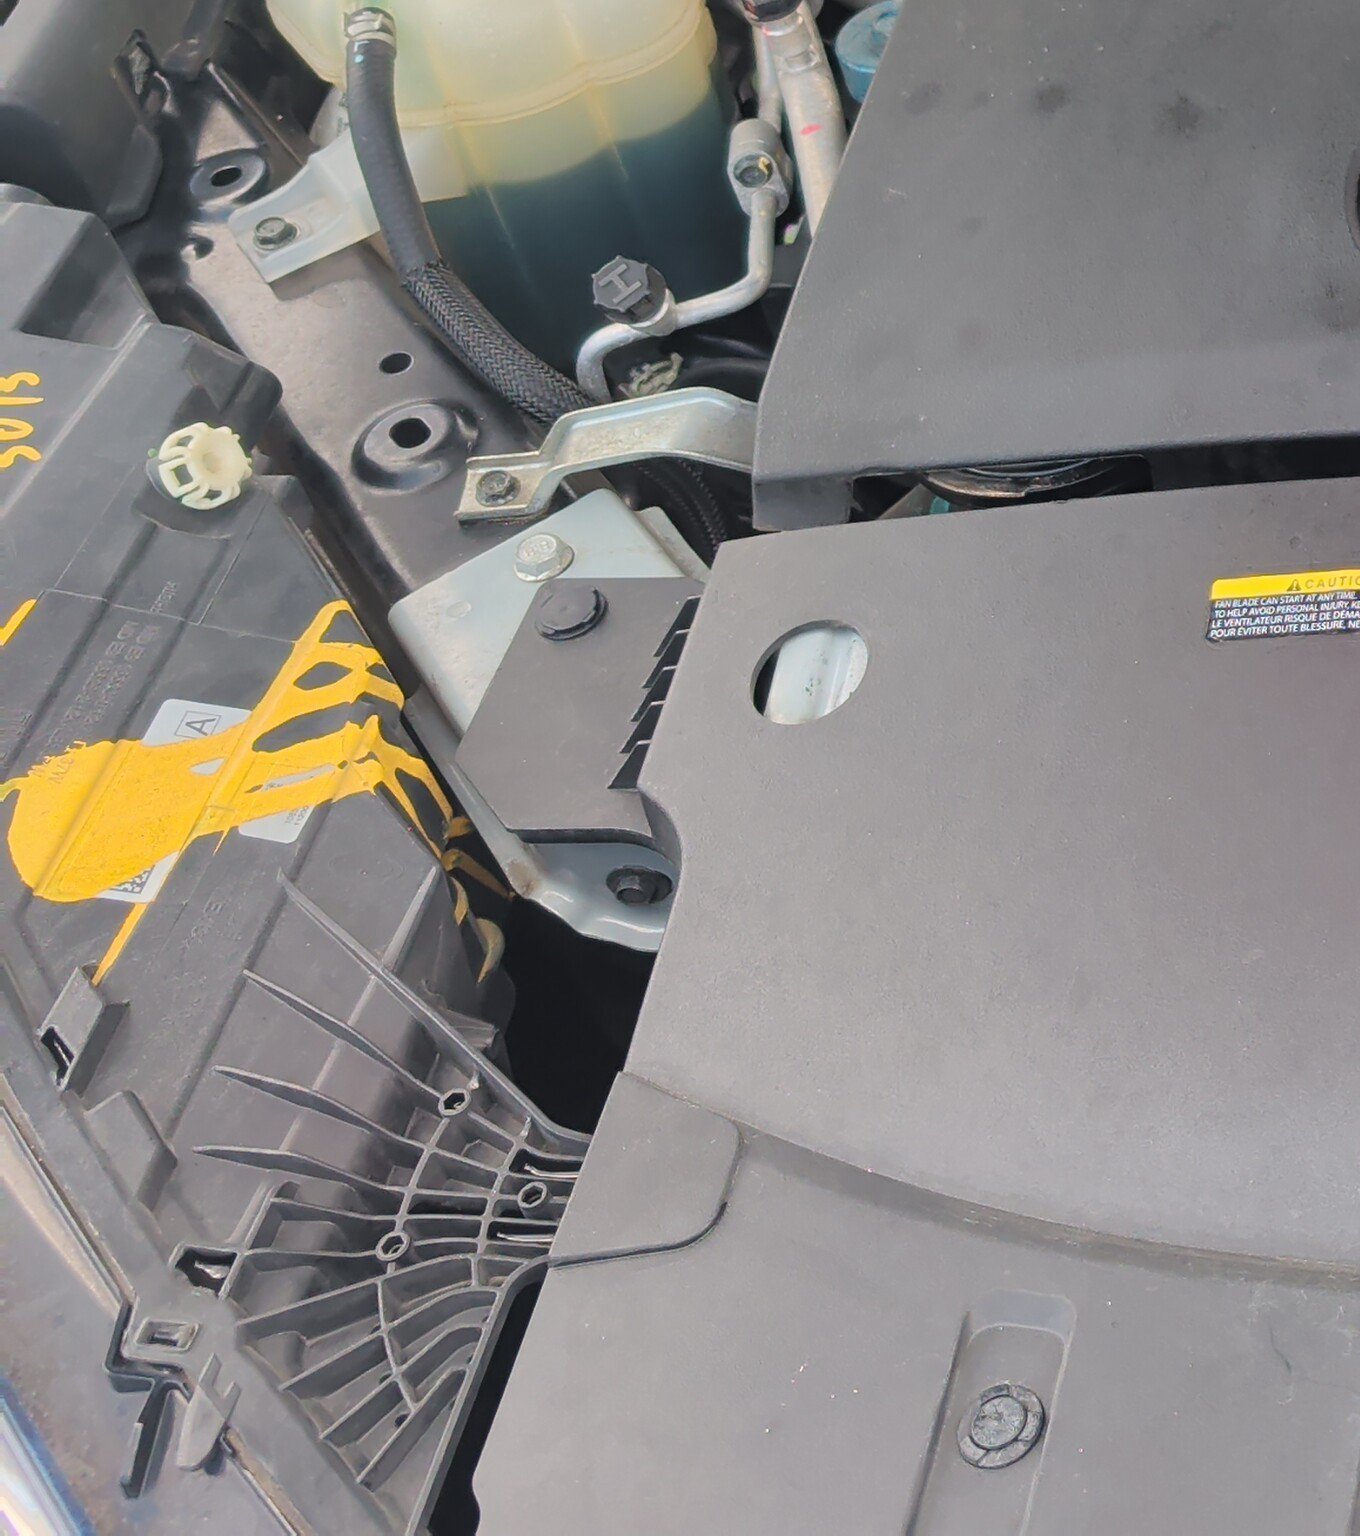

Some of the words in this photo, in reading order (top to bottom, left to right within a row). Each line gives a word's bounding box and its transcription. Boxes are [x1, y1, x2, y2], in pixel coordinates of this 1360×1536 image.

[1215, 600, 1231, 609] FAN
[1231, 598, 1259, 607] BLADE
[1260, 596, 1279, 605] CAN
[1280, 595, 1306, 604] START
[1306, 593, 1318, 602] AT
[1317, 592, 1336, 602] ANY
[1214, 609, 1226, 618] TO
[1227, 607, 1248, 617] HELP
[1248, 605, 1275, 616] AVOID
[1276, 603, 1319, 614] PERSONAL
[1212, 619, 1224, 628] LE
[1224, 614, 1283, 628] VENTILATEUR
[1284, 612, 1317, 624] RISQUE
[1320, 611, 1331, 621] DE
[1210, 627, 1236, 638] POUR
[1237, 624, 1268, 636] ÉVITER
[1269, 623, 1298, 633] TOUTE
[1348, 619, 1360, 629] NE
[184, 716, 217, 736] A
